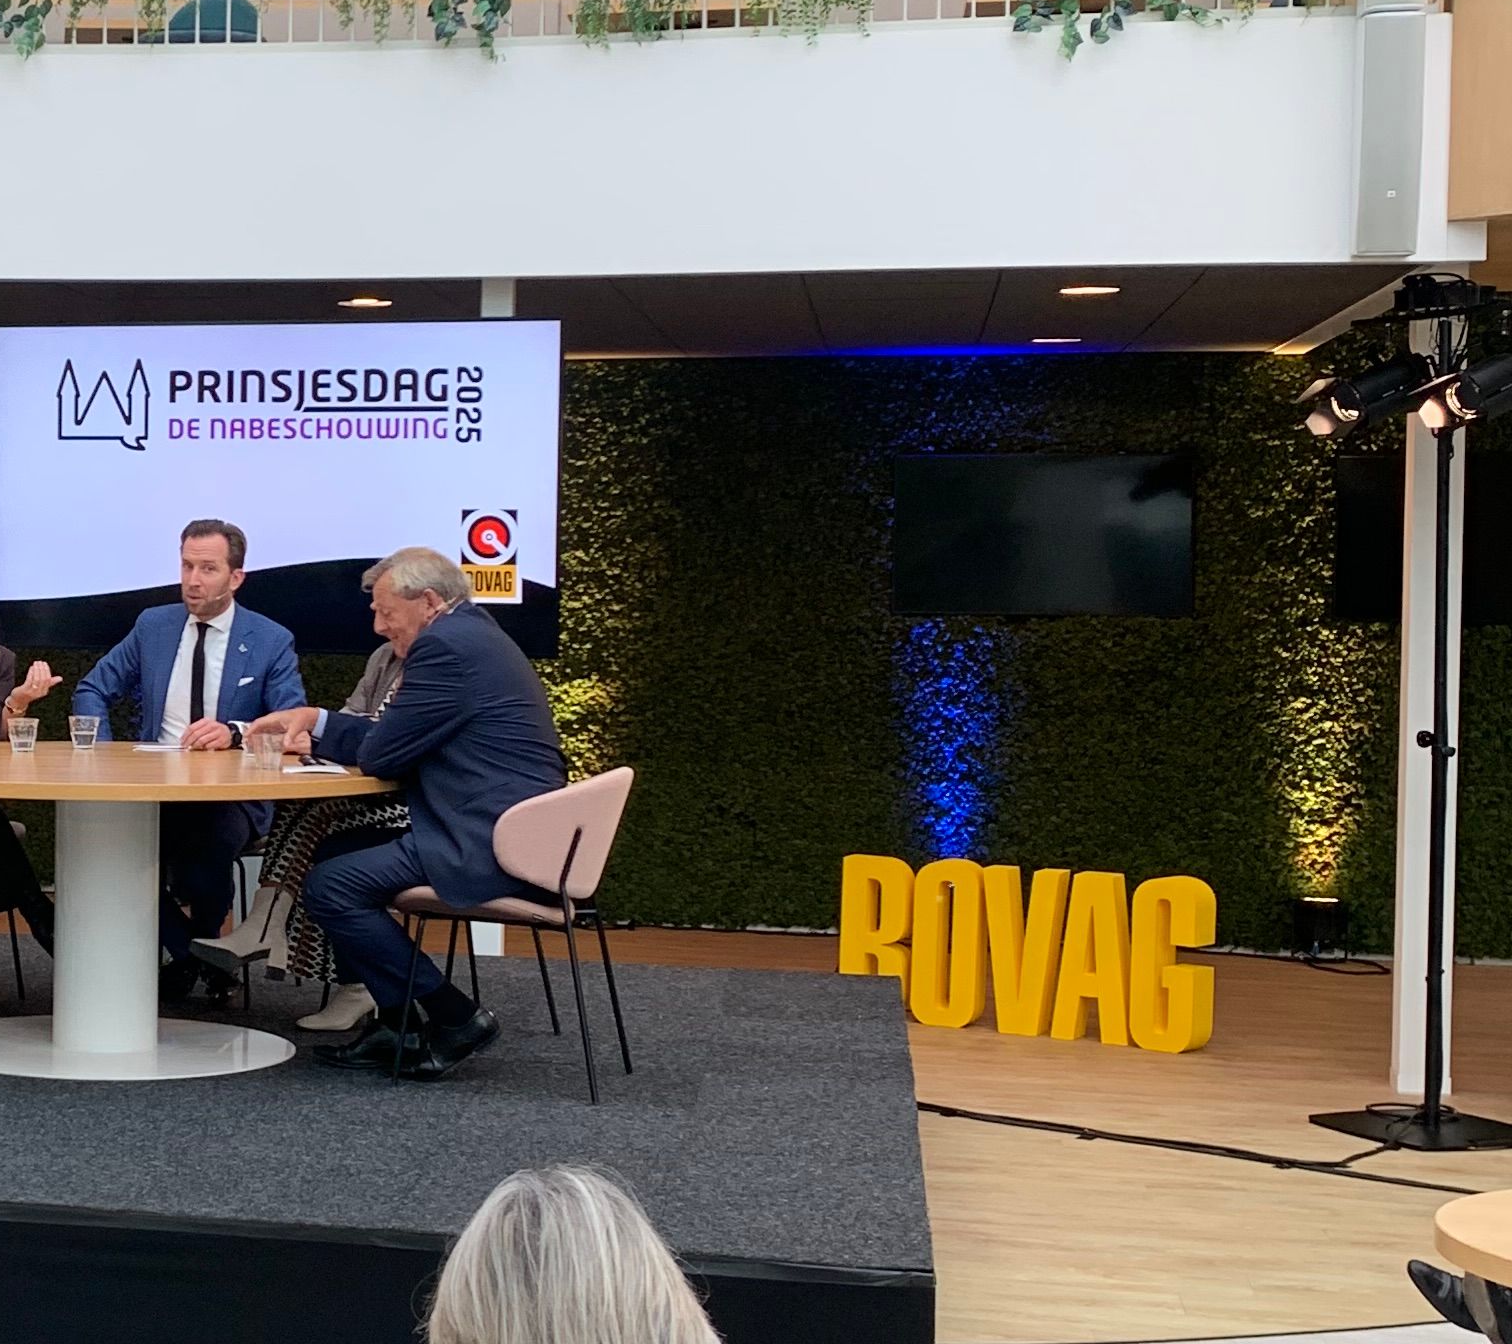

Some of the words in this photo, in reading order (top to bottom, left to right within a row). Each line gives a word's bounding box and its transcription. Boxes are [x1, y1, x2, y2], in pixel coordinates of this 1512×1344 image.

[168, 367, 449, 412] PRINSJESDAG
[455, 366, 484, 444] 2025
[168, 417, 201, 440] DE
[209, 417, 449, 440] NABESCHOUWING
